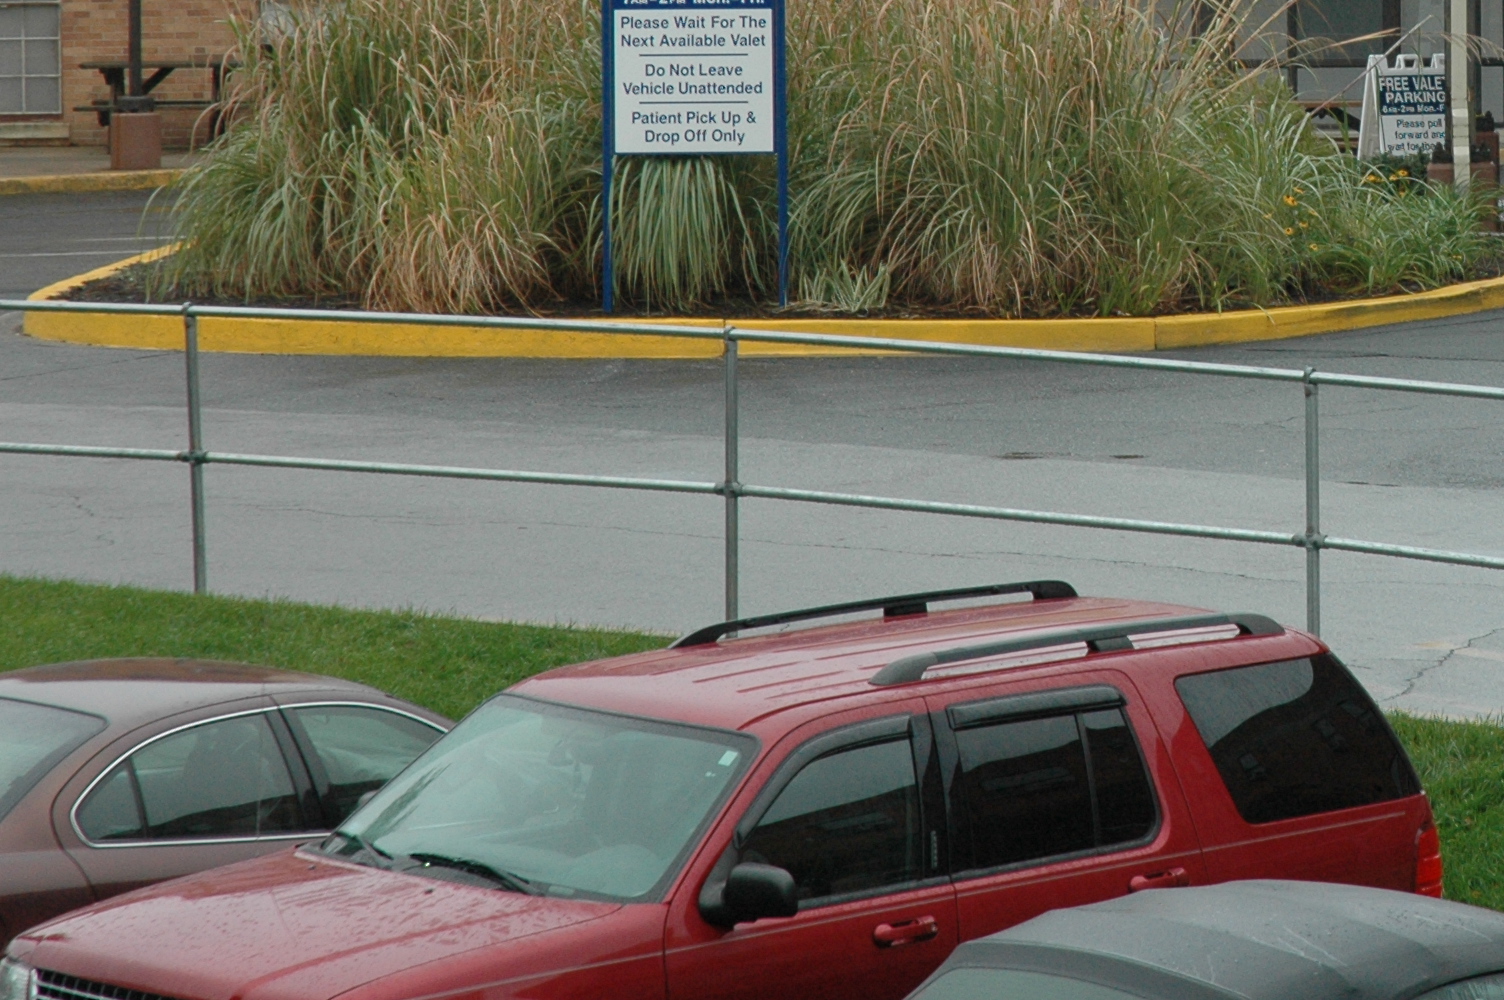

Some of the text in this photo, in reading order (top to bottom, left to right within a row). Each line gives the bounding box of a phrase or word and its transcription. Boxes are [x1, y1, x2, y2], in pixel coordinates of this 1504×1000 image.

[621, 15, 766, 29] Please Wait For The
[621, 34, 766, 47] Next Available Valet
[645, 63, 743, 77] Do Not Leave
[623, 81, 763, 95] Vehicle Unattended
[1379, 76, 1409, 91] FREE
[1386, 91, 1445, 104] PARKING
[631, 111, 757, 126] Patient Pick Up &
[1396, 119, 1425, 128] Please
[644, 129, 745, 145] Drop Off Only
[1395, 130, 1429, 139] forward
